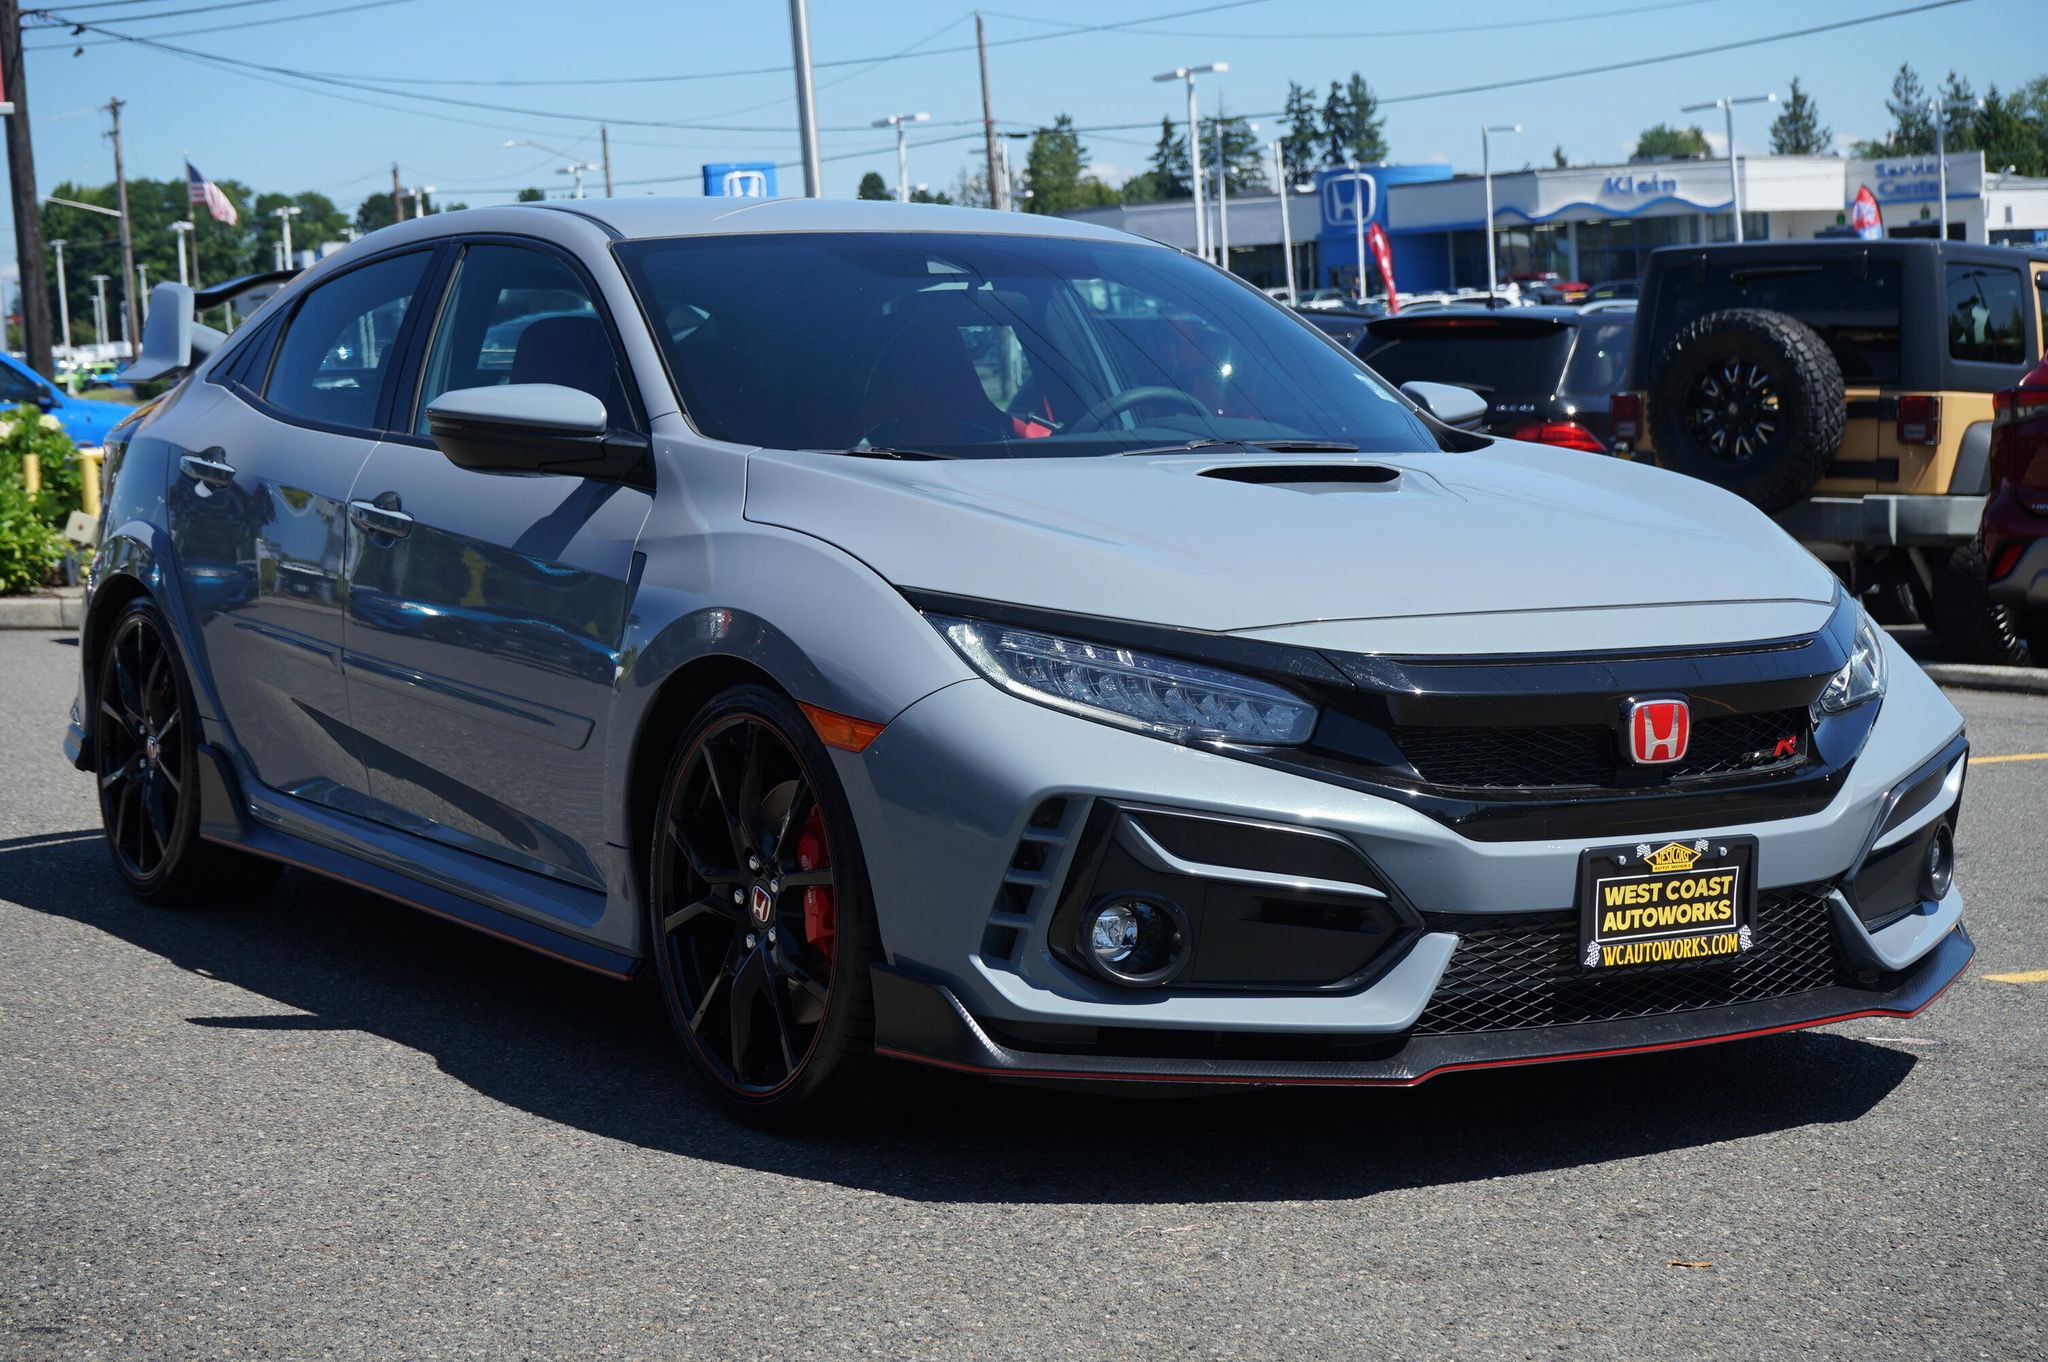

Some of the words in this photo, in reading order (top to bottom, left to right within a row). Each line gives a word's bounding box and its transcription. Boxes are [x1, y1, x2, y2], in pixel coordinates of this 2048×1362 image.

[1605, 173, 1677, 195] Klein
[1875, 159, 1949, 178] Servic
[1605, 882, 1663, 906] WEST
[1666, 875, 1733, 901] COAST
[1602, 899, 1731, 932] AUTOWORKS
[1602, 933, 1738, 966] WCAUTOWORKS.COM
